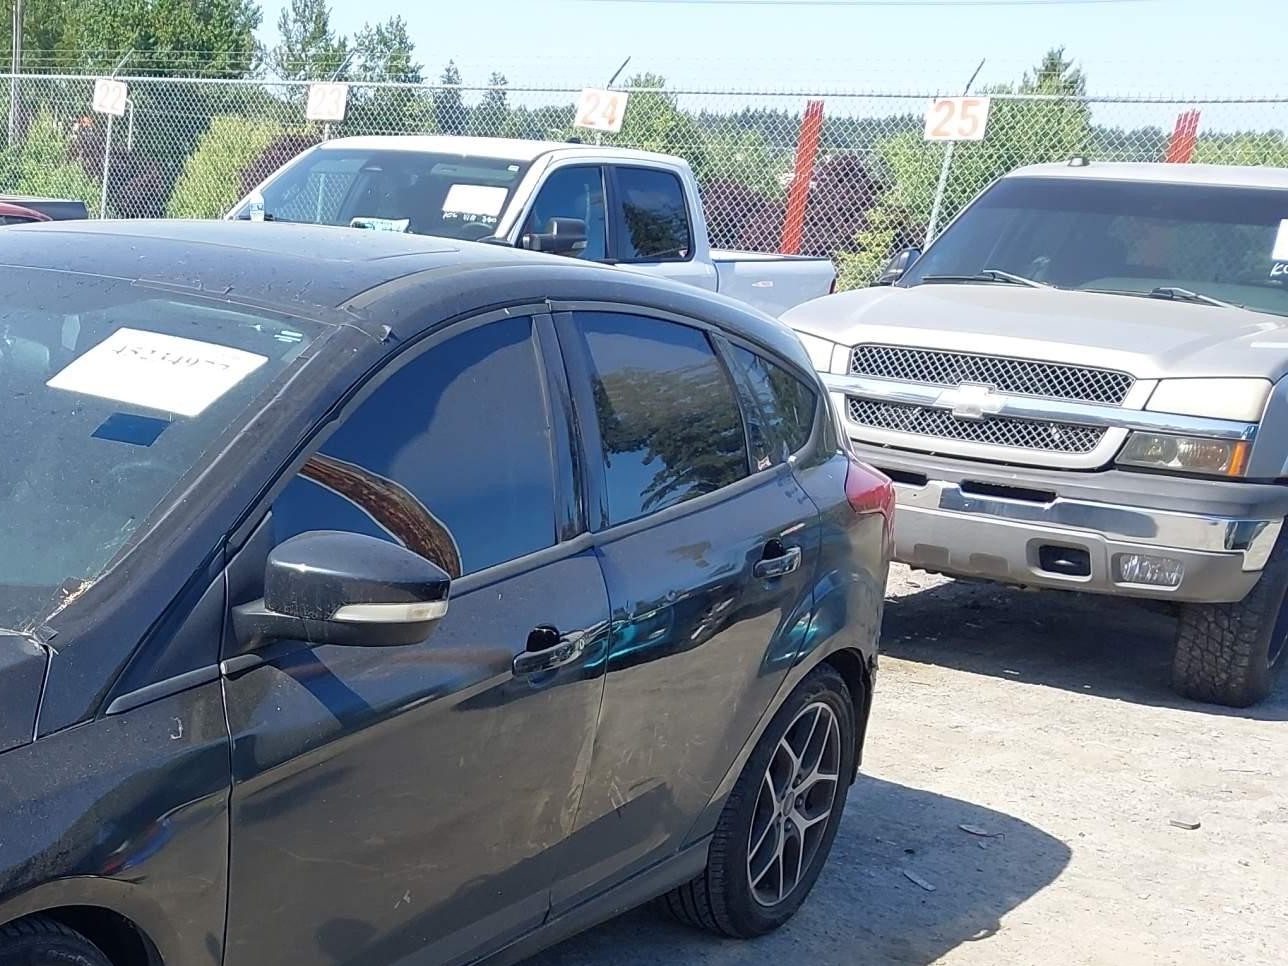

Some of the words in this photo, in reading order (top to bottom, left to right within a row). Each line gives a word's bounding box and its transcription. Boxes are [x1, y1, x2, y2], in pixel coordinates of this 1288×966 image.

[98, 82, 122, 111] 22
[312, 87, 342, 116] 23
[583, 92, 618, 125] 24
[932, 100, 980, 136] 25
